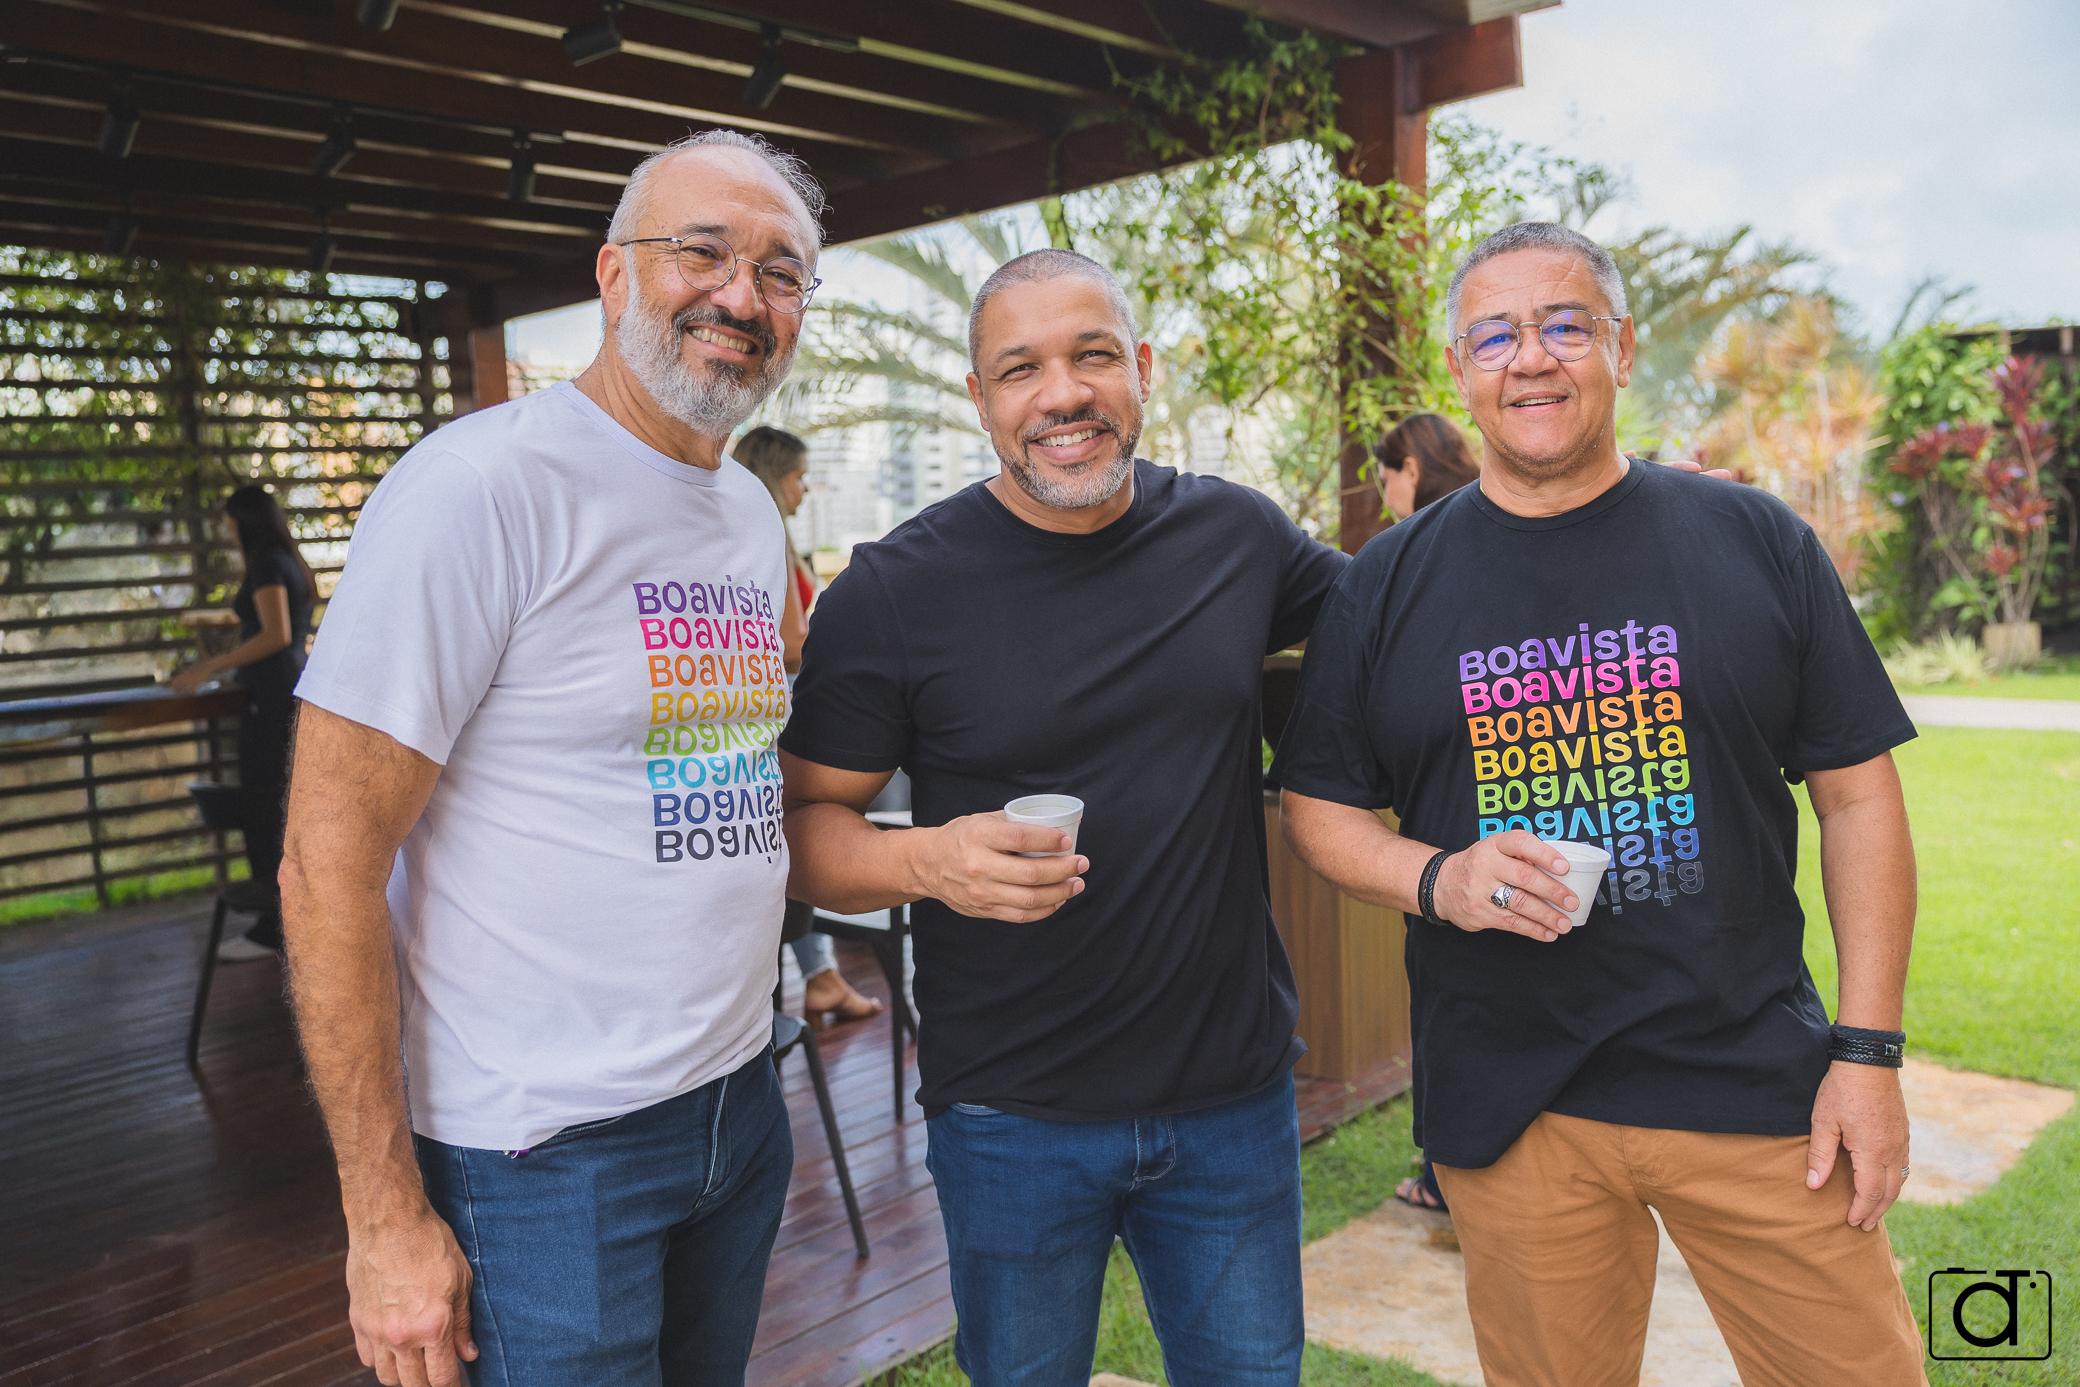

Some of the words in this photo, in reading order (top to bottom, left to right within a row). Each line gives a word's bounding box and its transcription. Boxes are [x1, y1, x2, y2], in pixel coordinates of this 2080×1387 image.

[632, 575, 774, 620] Boavista
[639, 609, 780, 652] Boavista
[1459, 619, 1678, 682] Boavista
[647, 643, 785, 688] Boavista
[1461, 651, 1681, 714] Boavista
[649, 679, 786, 725] Boavista
[1467, 686, 1683, 747] Boavista
[1473, 720, 1688, 781] Boavista
